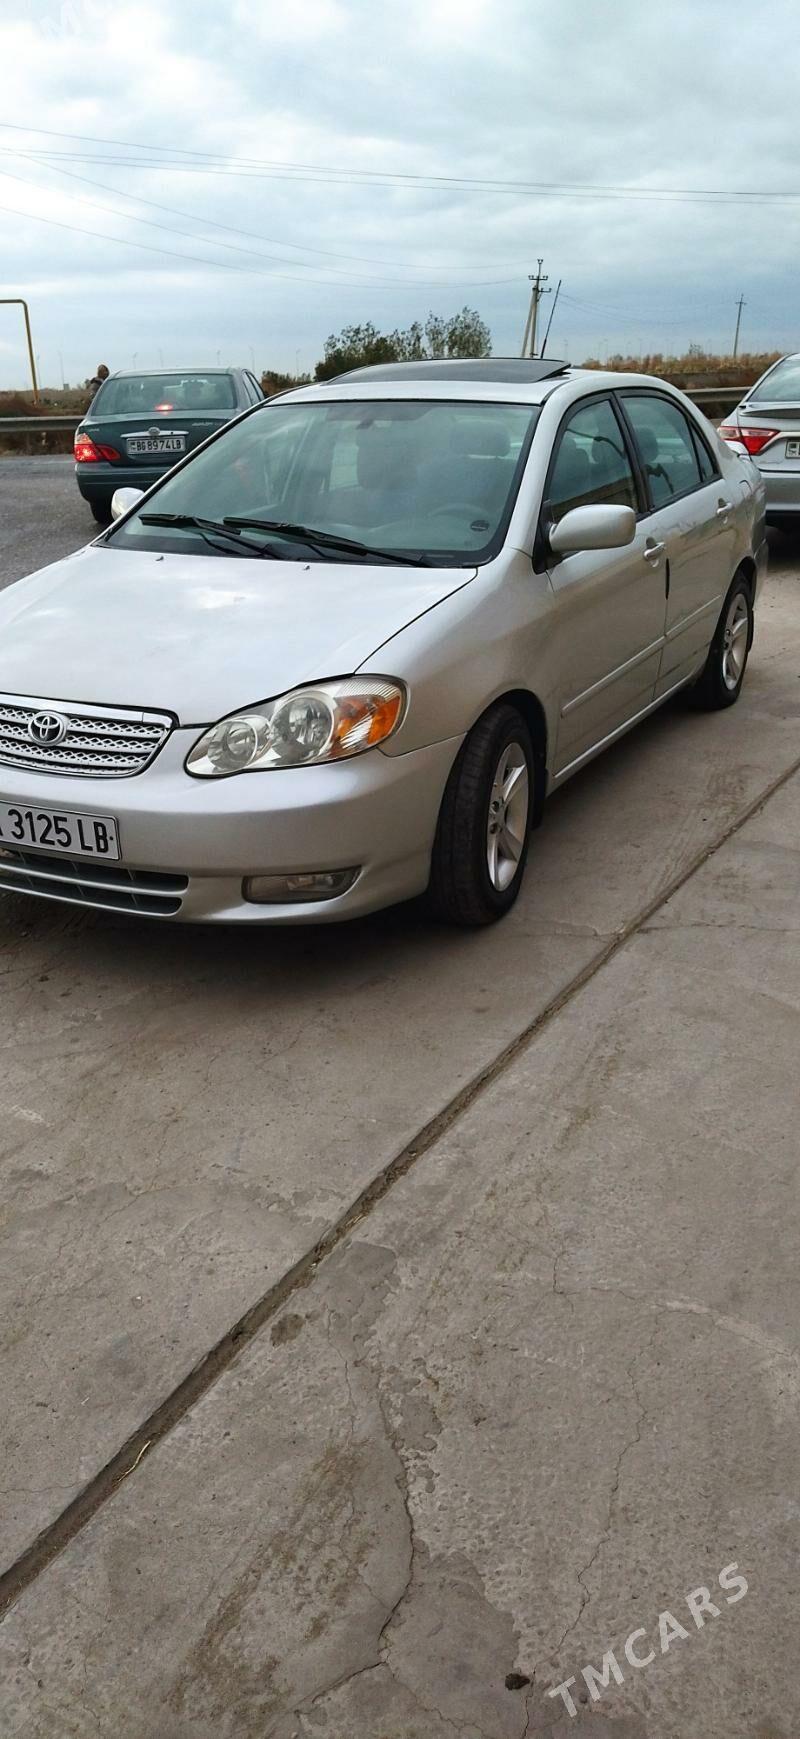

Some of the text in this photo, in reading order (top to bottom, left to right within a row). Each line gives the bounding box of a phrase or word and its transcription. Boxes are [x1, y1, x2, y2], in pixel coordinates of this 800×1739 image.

[147, 440, 171, 450] 8974
[172, 440, 181, 449] LB
[8, 809, 109, 853] 3125 LB
